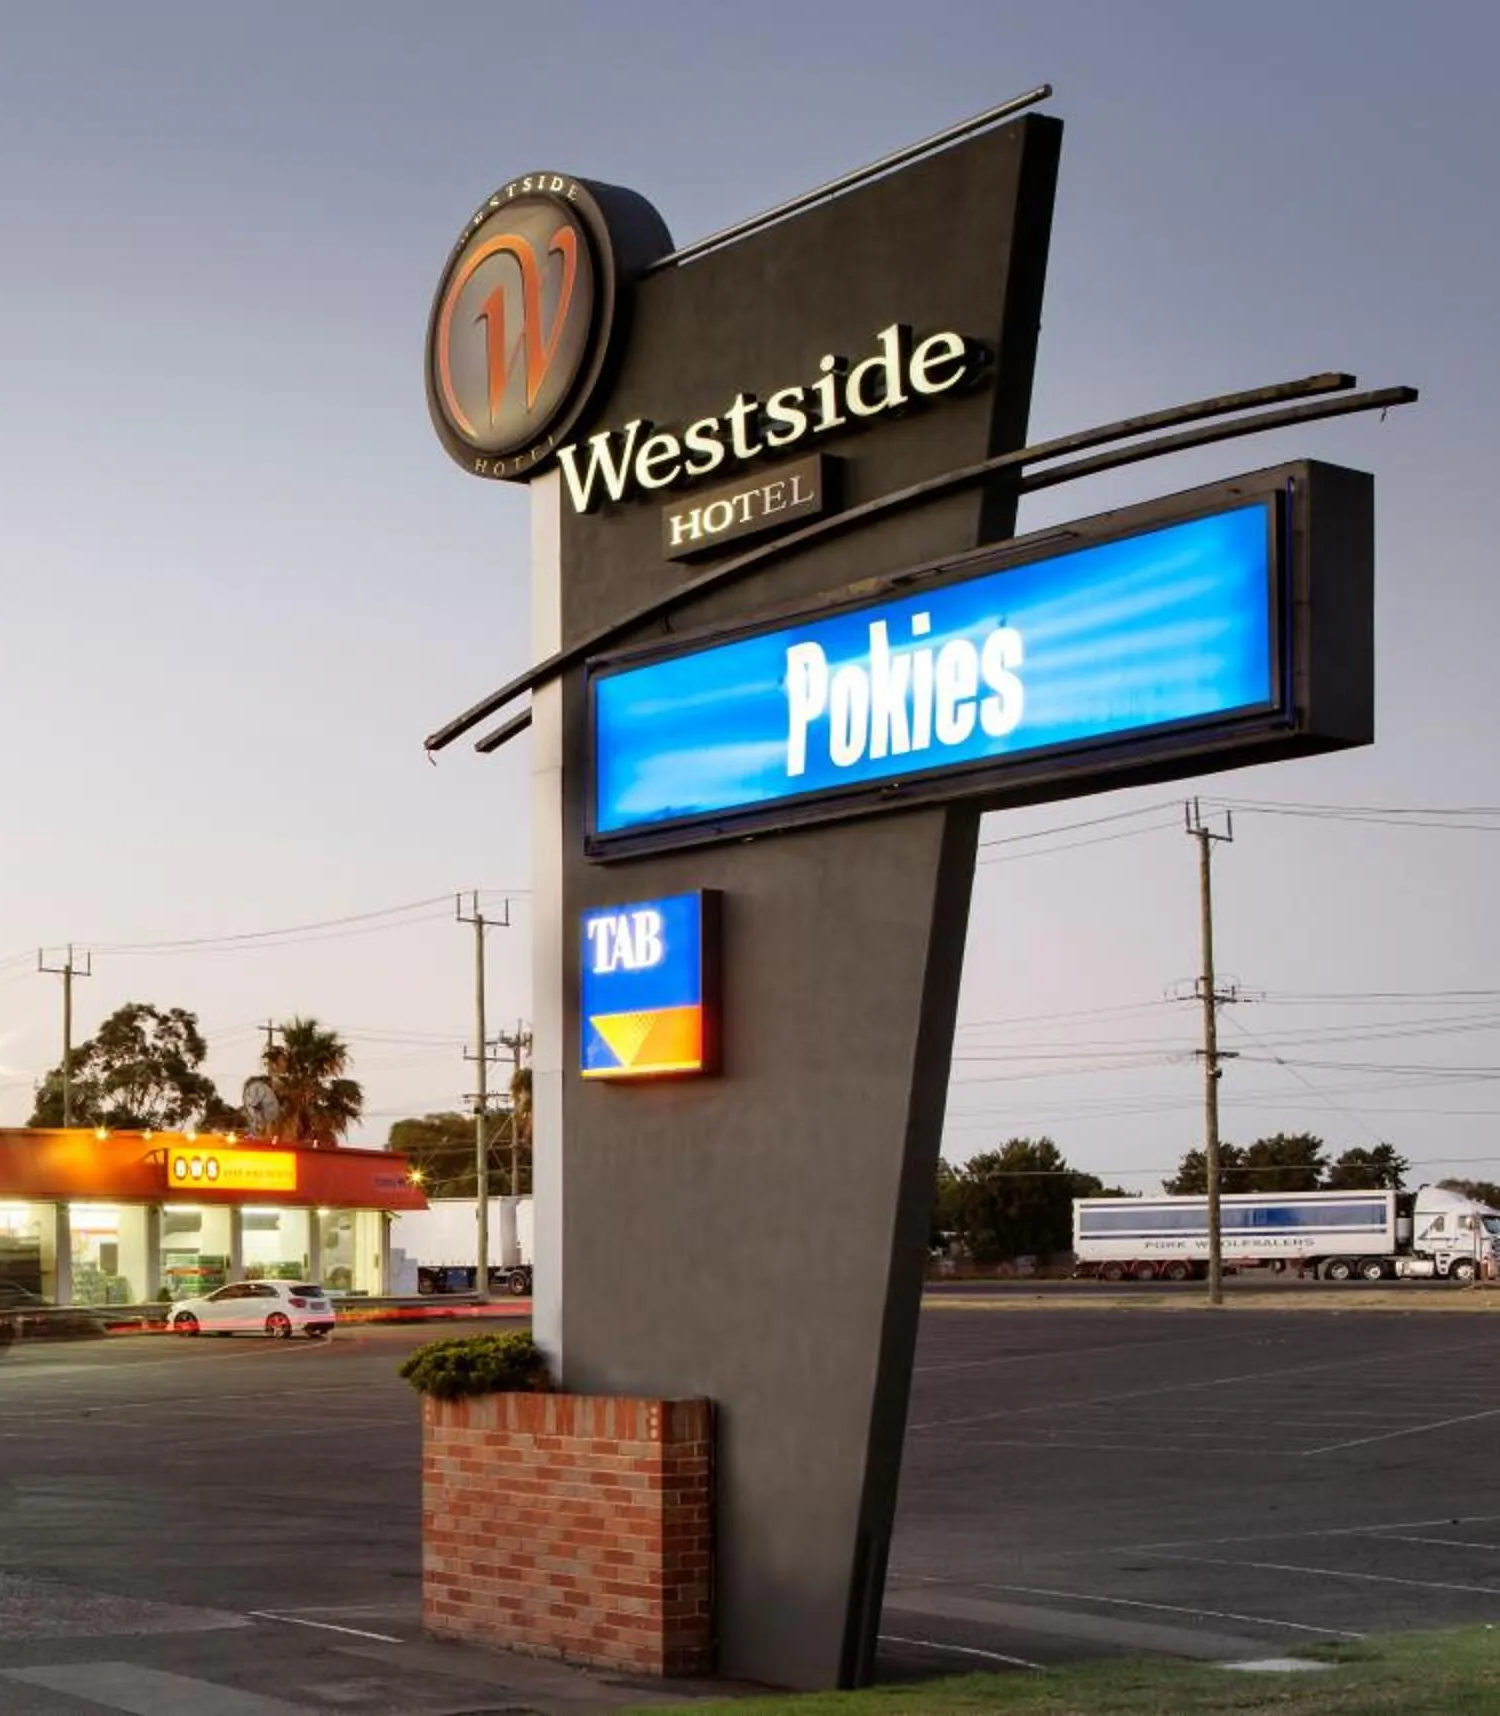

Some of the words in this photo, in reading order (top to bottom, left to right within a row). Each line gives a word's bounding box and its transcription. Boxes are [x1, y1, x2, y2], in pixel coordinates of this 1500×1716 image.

[557, 323, 967, 514] Westside
[669, 474, 815, 545] HOTEL
[786, 611, 1025, 777] Pokies
[588, 908, 664, 974] TAB
[1195, 1237, 1316, 1249] WOLESALERS
